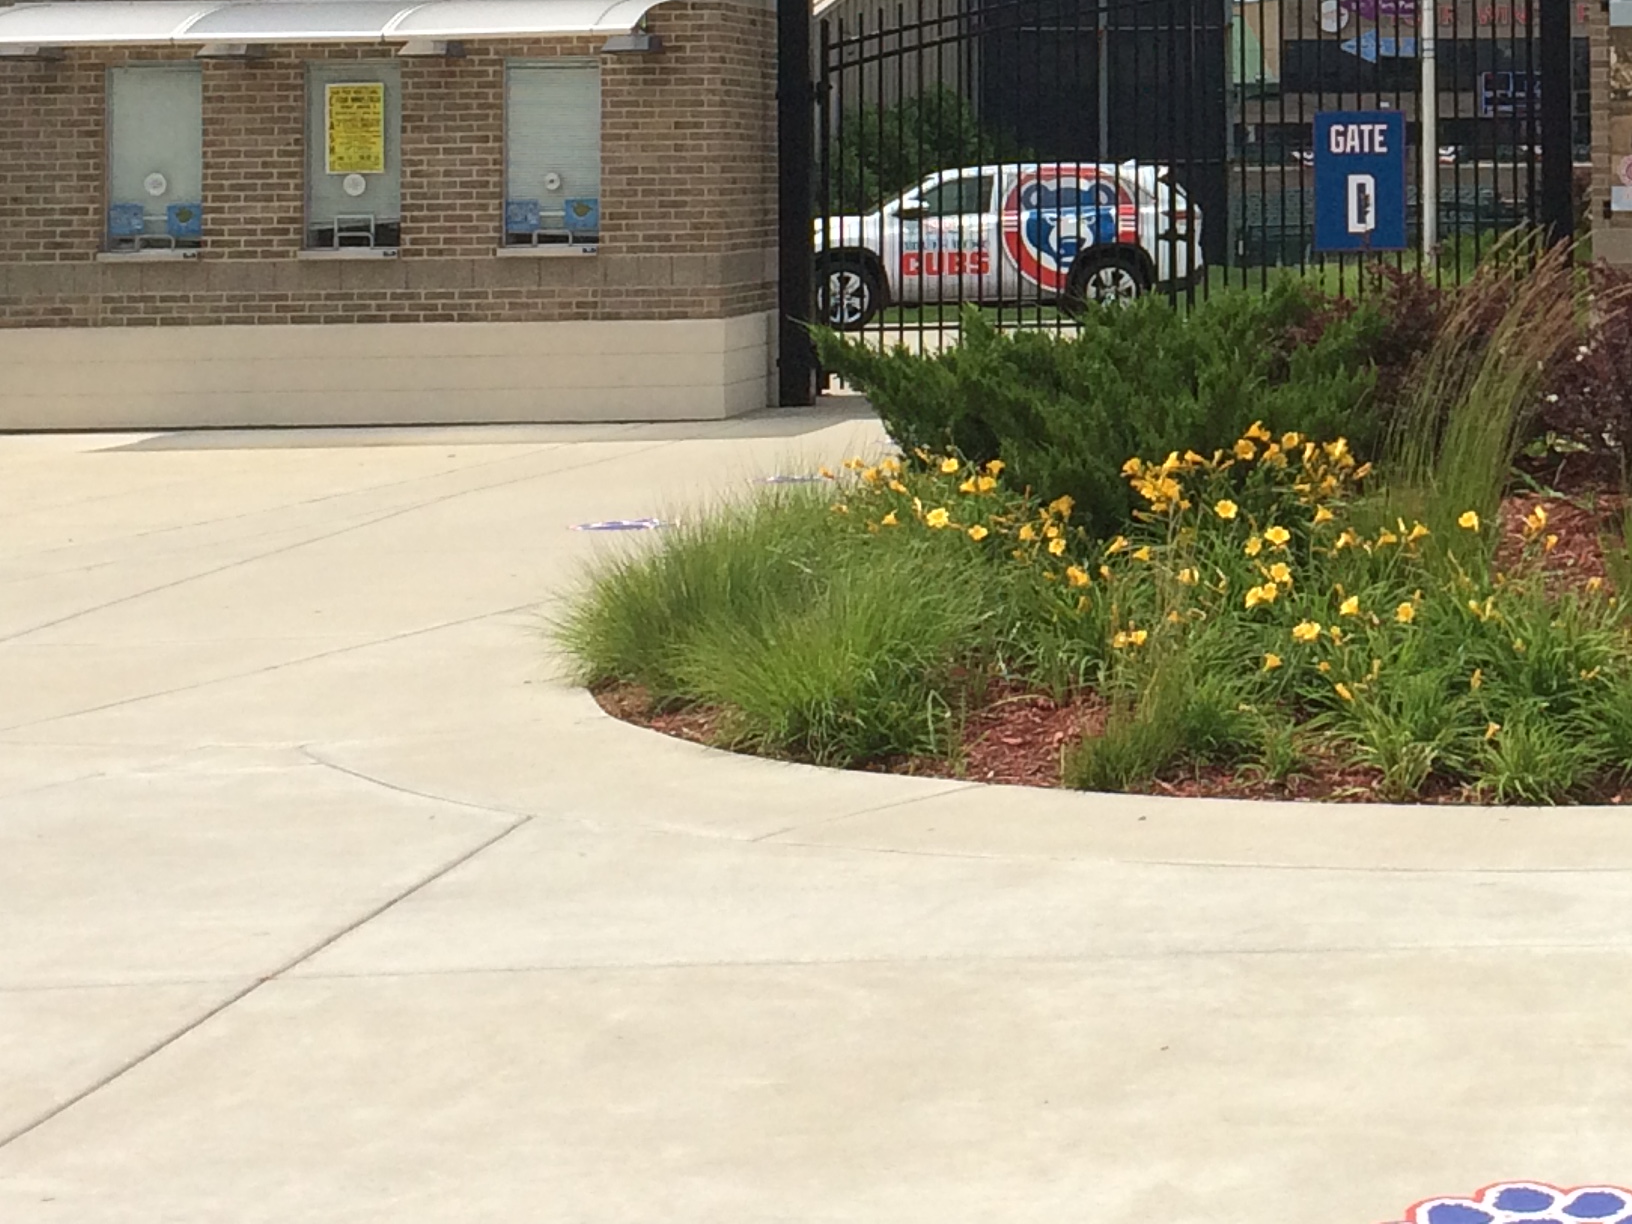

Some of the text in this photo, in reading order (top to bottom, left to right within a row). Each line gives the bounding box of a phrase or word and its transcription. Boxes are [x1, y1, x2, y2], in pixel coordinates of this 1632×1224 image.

[1330, 124, 1388, 154] GATE
[1347, 174, 1375, 233] D
[903, 251, 990, 276] CUBS
